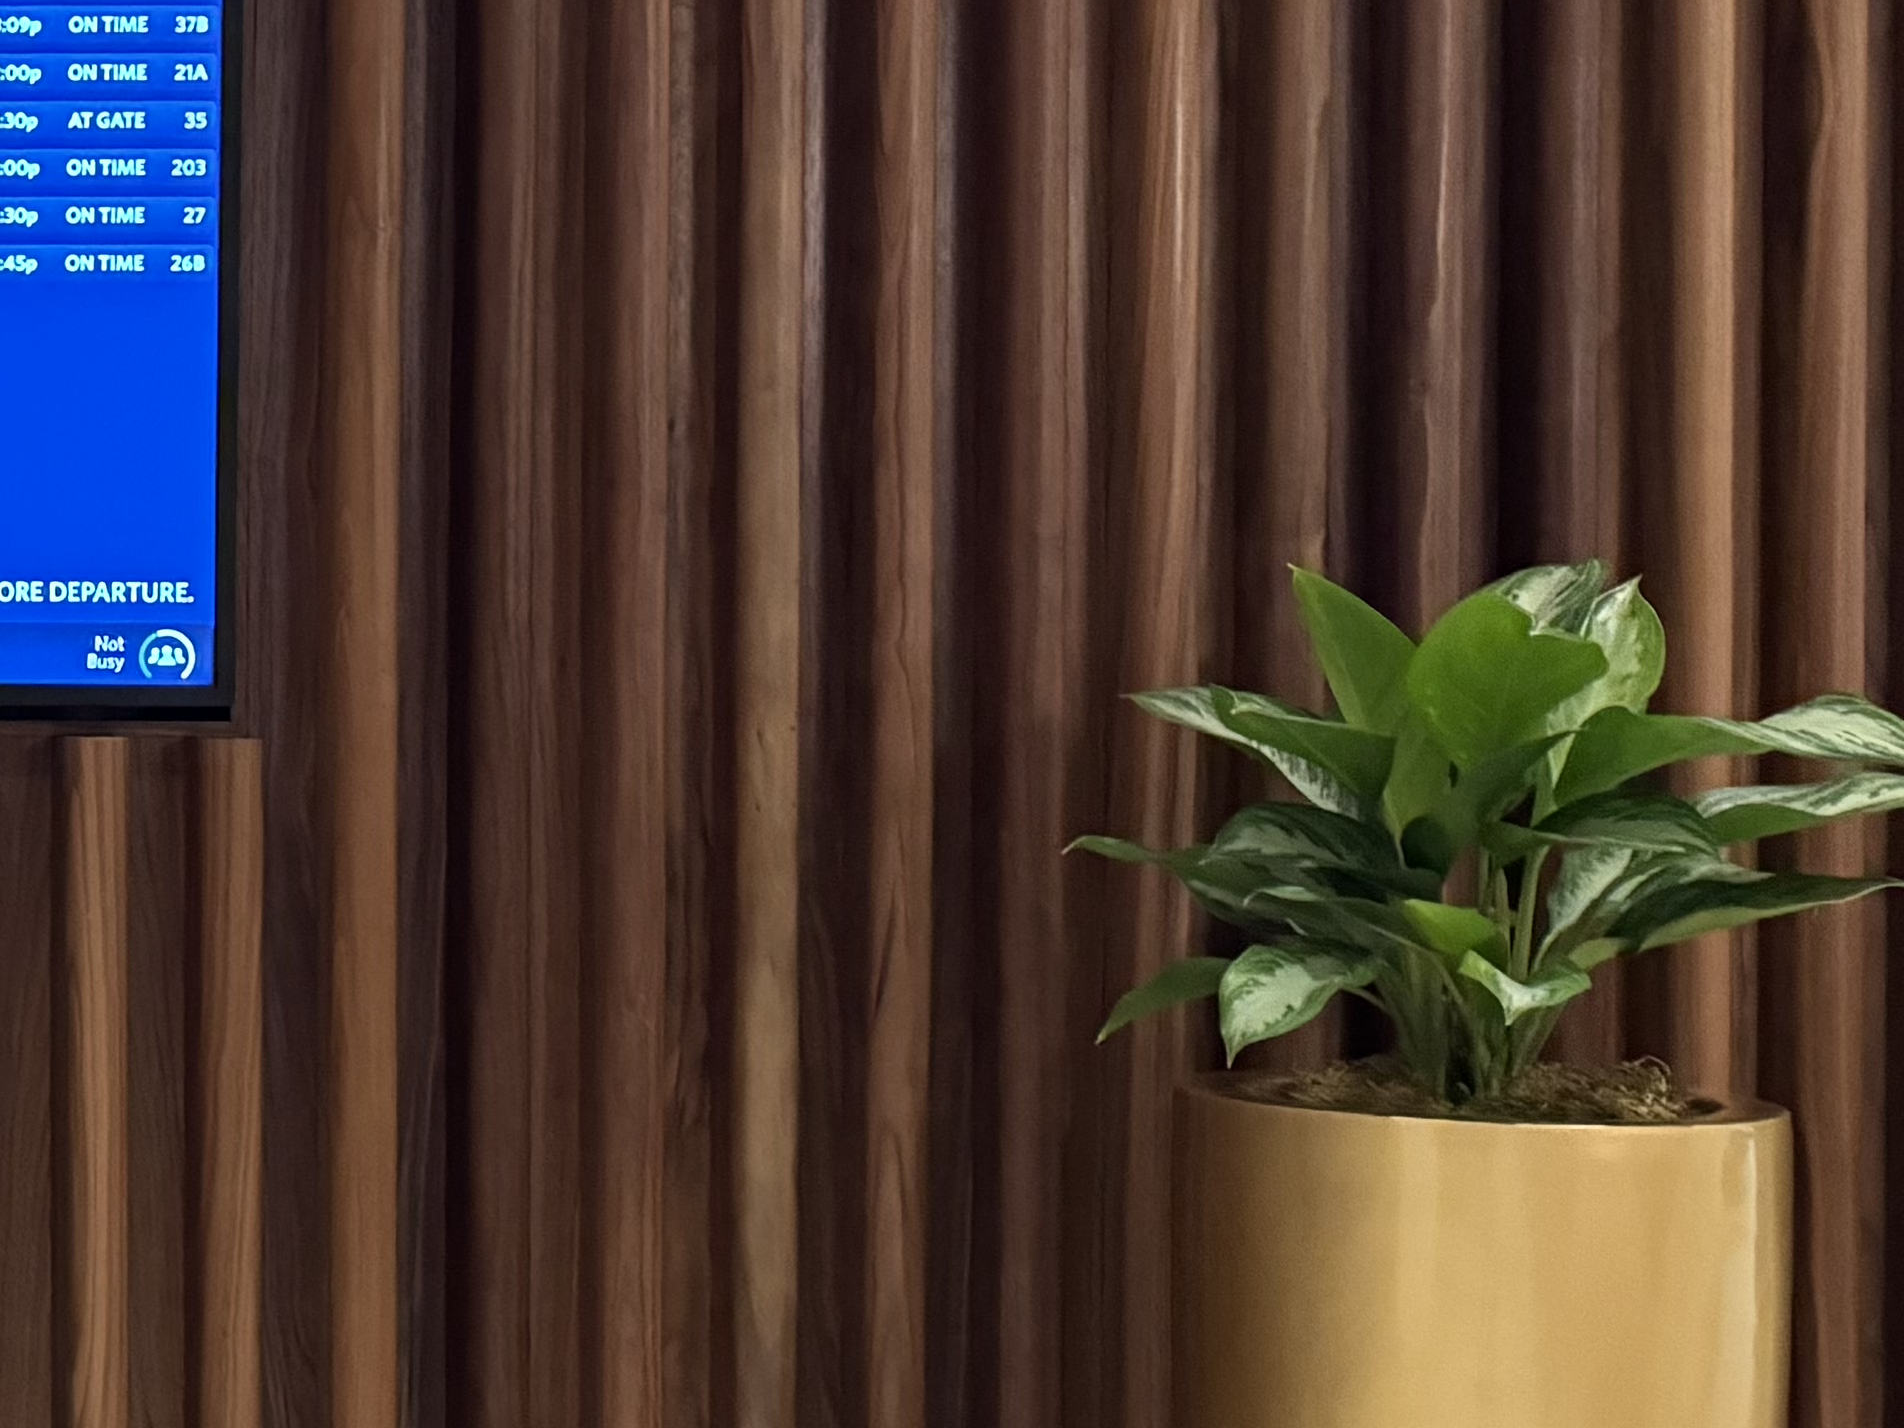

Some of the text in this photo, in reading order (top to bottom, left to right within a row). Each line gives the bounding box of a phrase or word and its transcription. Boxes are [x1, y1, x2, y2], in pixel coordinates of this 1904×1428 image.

[66, 158, 96, 177] ON
[99, 158, 146, 176] TIME
[171, 158, 206, 176] 203
[65, 206, 95, 224] ON
[98, 206, 145, 224] TIME
[183, 206, 206, 224] 27
[49, 581, 195, 604] DEPARTURE.
[94, 635, 125, 652] Not
[86, 652, 125, 673] Busy
